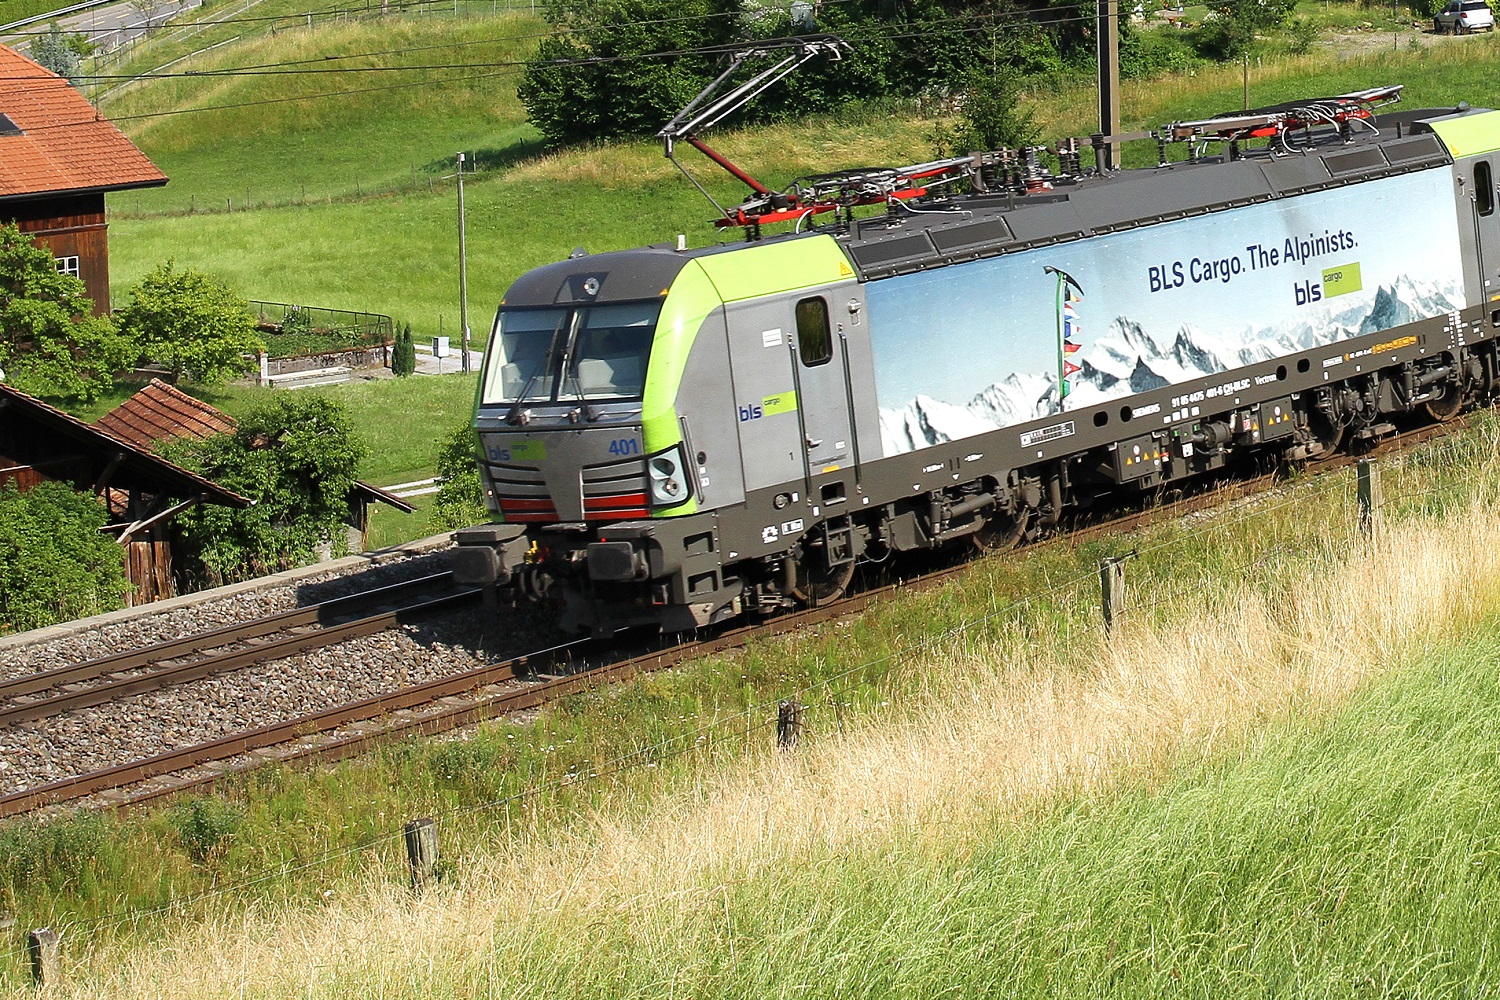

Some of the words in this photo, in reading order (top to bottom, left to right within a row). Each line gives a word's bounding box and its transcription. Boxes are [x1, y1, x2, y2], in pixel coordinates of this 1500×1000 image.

[1148, 261, 1185, 293] BLS
[1189, 256, 1246, 283] Cargo.
[1246, 244, 1279, 271] The
[1283, 229, 1359, 266] Alpinists.
[1323, 270, 1343, 283] cargo
[1293, 279, 1322, 306] bls
[1254, 373, 1277, 386] Vectron
[763, 397, 781, 406] cargo
[1171, 396, 1180, 408] 91
[739, 404, 762, 422] bls
[1132, 402, 1161, 418] SIEMENS
[487, 444, 511, 461] bls
[608, 438, 639, 456] 401
